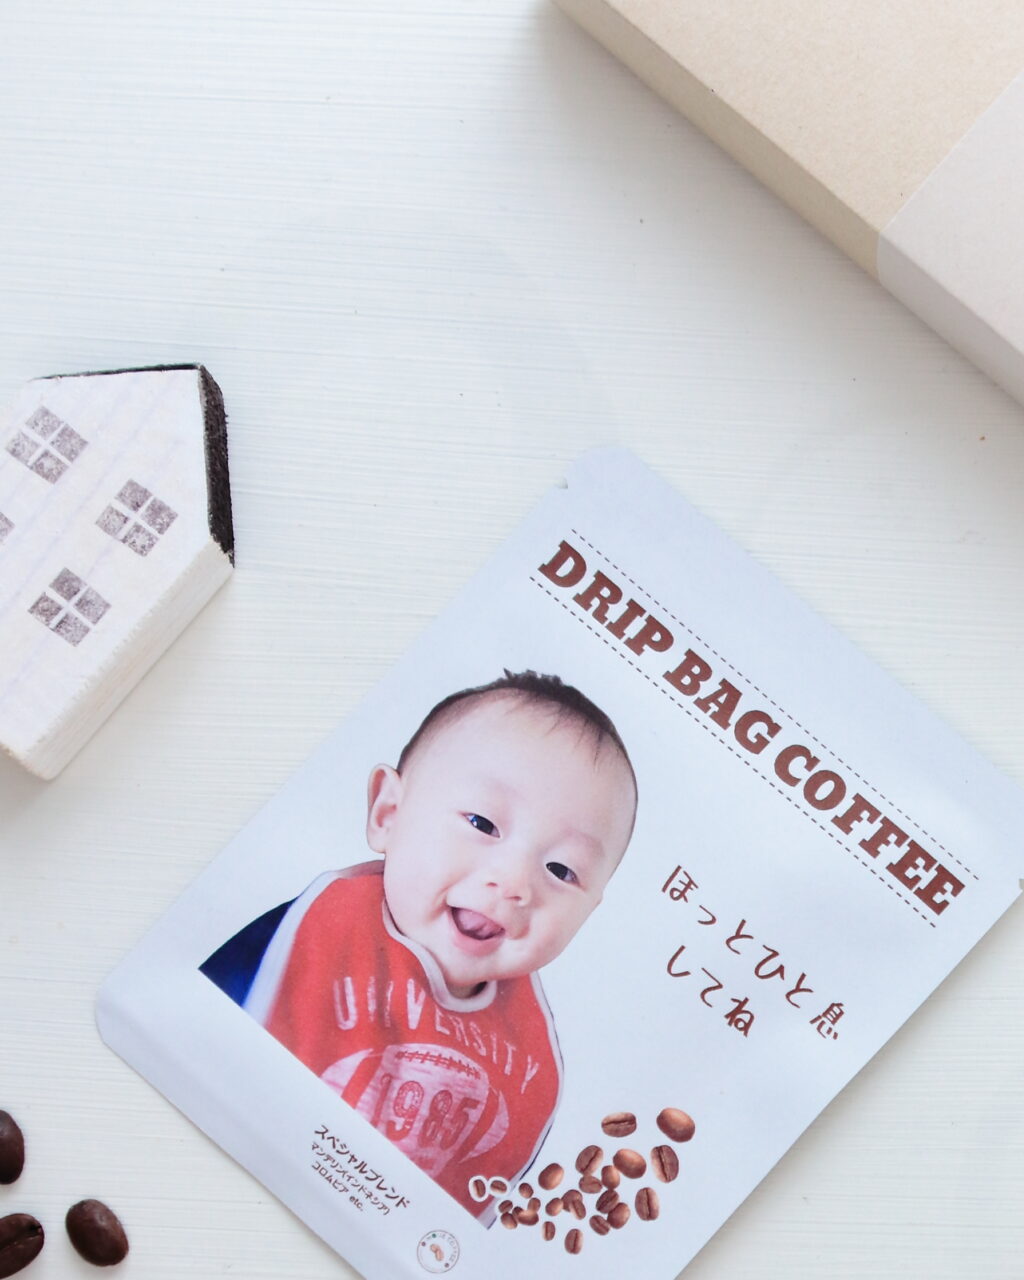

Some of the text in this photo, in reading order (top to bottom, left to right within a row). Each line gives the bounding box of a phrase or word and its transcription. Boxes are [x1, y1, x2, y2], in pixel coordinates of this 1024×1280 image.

[537, 539, 966, 916] DRIP BAG COFFEE
[661, 865, 845, 1041] ほっとひと息
[666, 944, 755, 1038] してね
[314, 1124, 411, 1208] スペシャルブレンド
